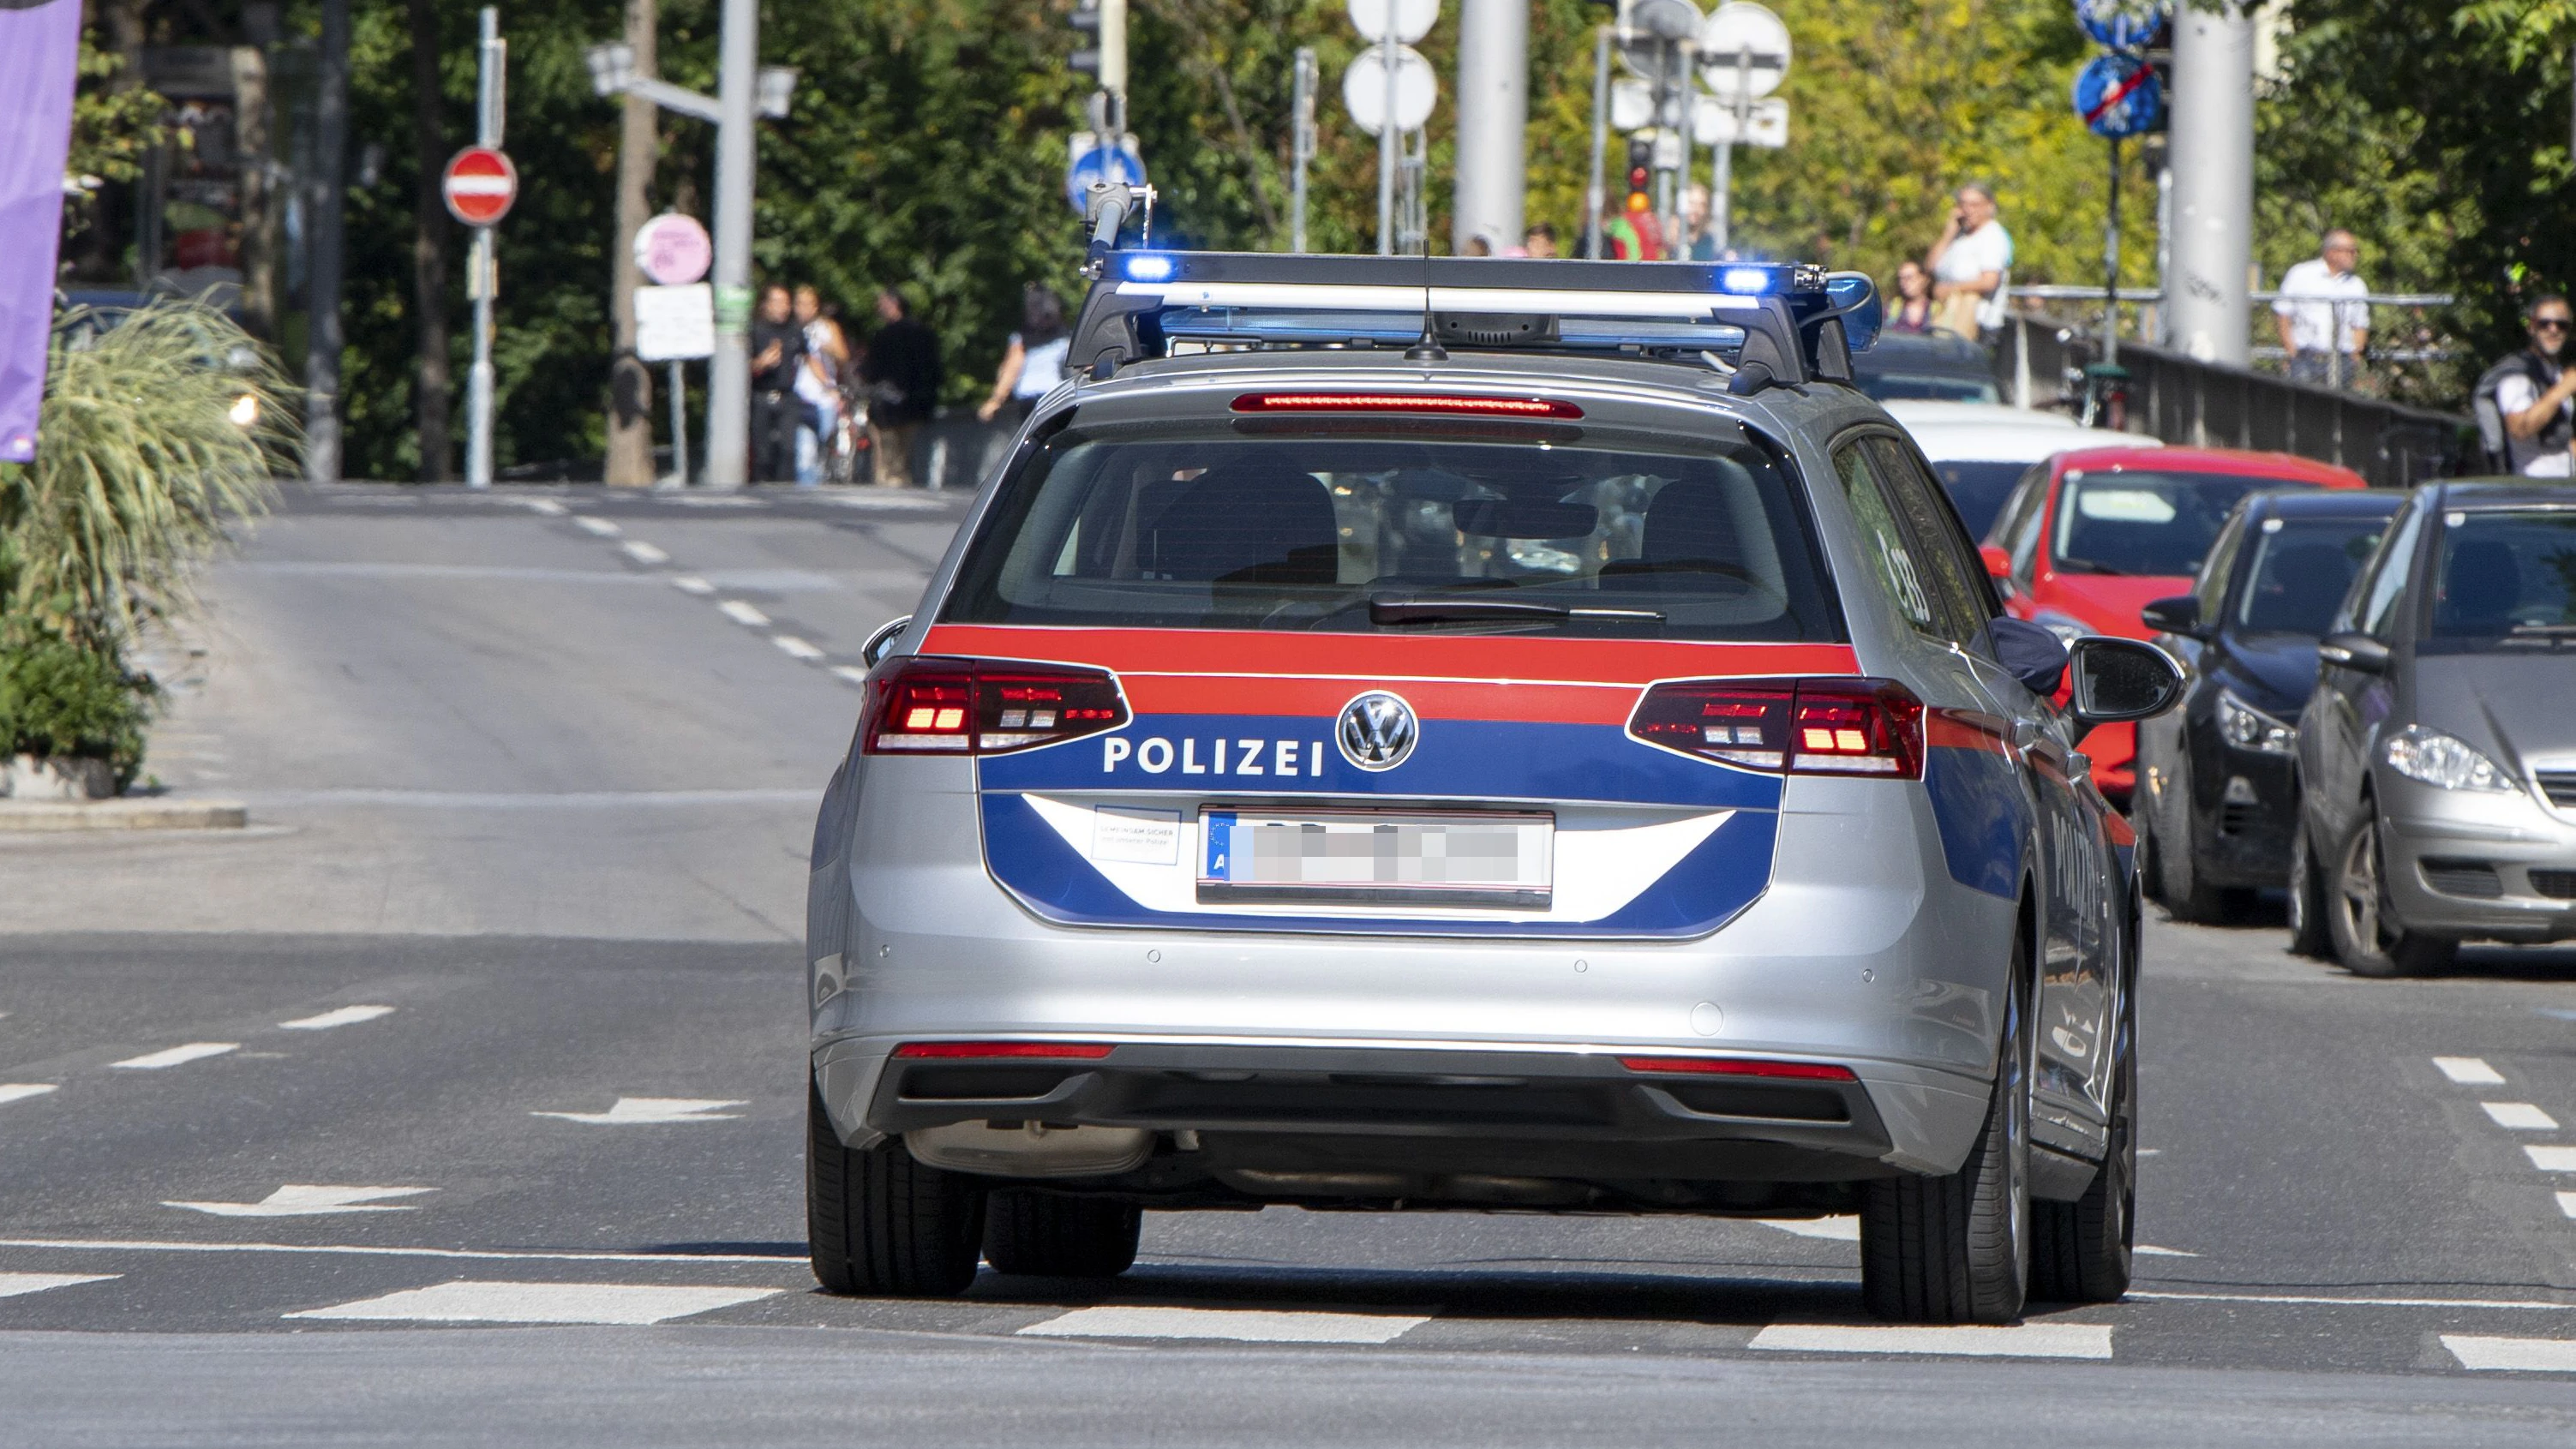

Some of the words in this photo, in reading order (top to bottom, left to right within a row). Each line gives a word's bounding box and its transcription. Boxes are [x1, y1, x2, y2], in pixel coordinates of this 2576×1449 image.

[1339, 692, 1416, 768] VW
[1103, 737, 1323, 777] POLIZEI
[1147, 829, 1174, 837] SICHER
